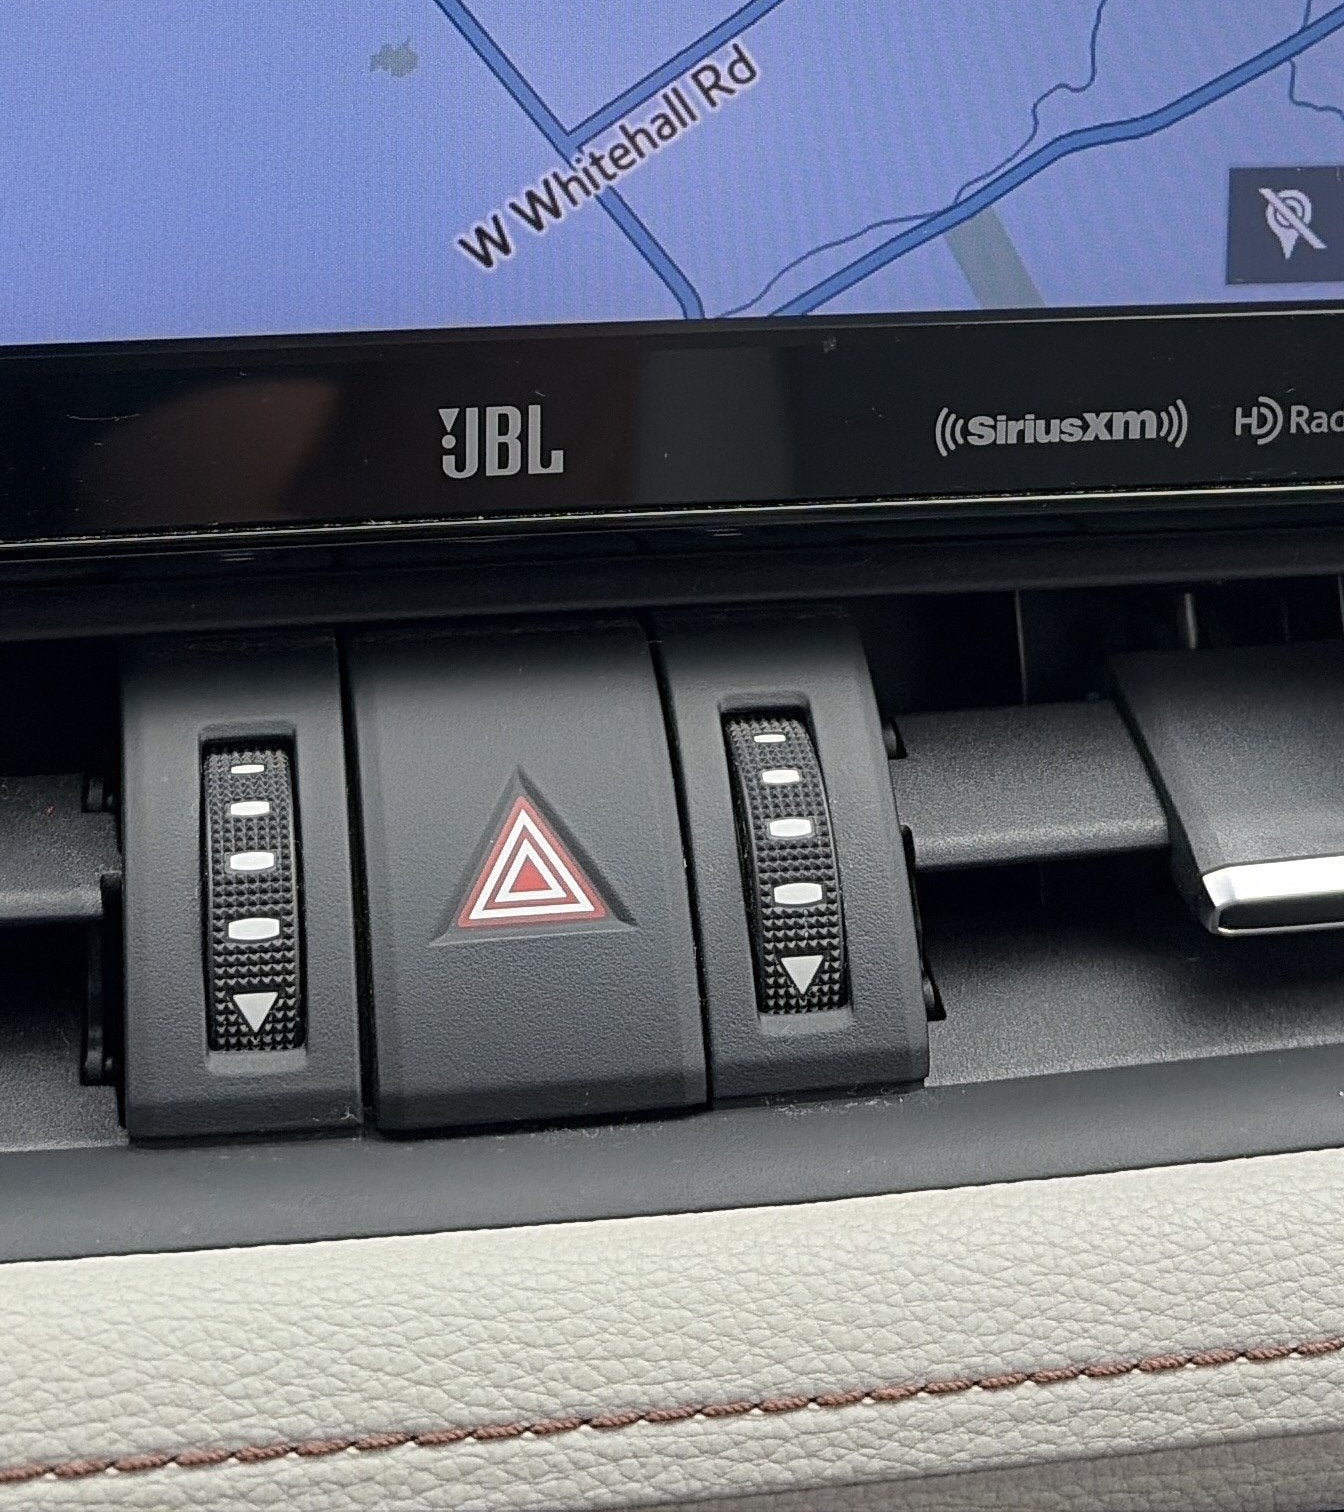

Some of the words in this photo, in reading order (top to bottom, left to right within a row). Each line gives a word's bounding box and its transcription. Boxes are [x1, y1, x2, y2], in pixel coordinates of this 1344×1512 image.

[457, 214, 512, 269] W
[510, 86, 697, 233] Whitehall
[692, 42, 758, 112] Rd
[439, 404, 564, 479] JBL
[1235, 395, 1284, 445] HD
